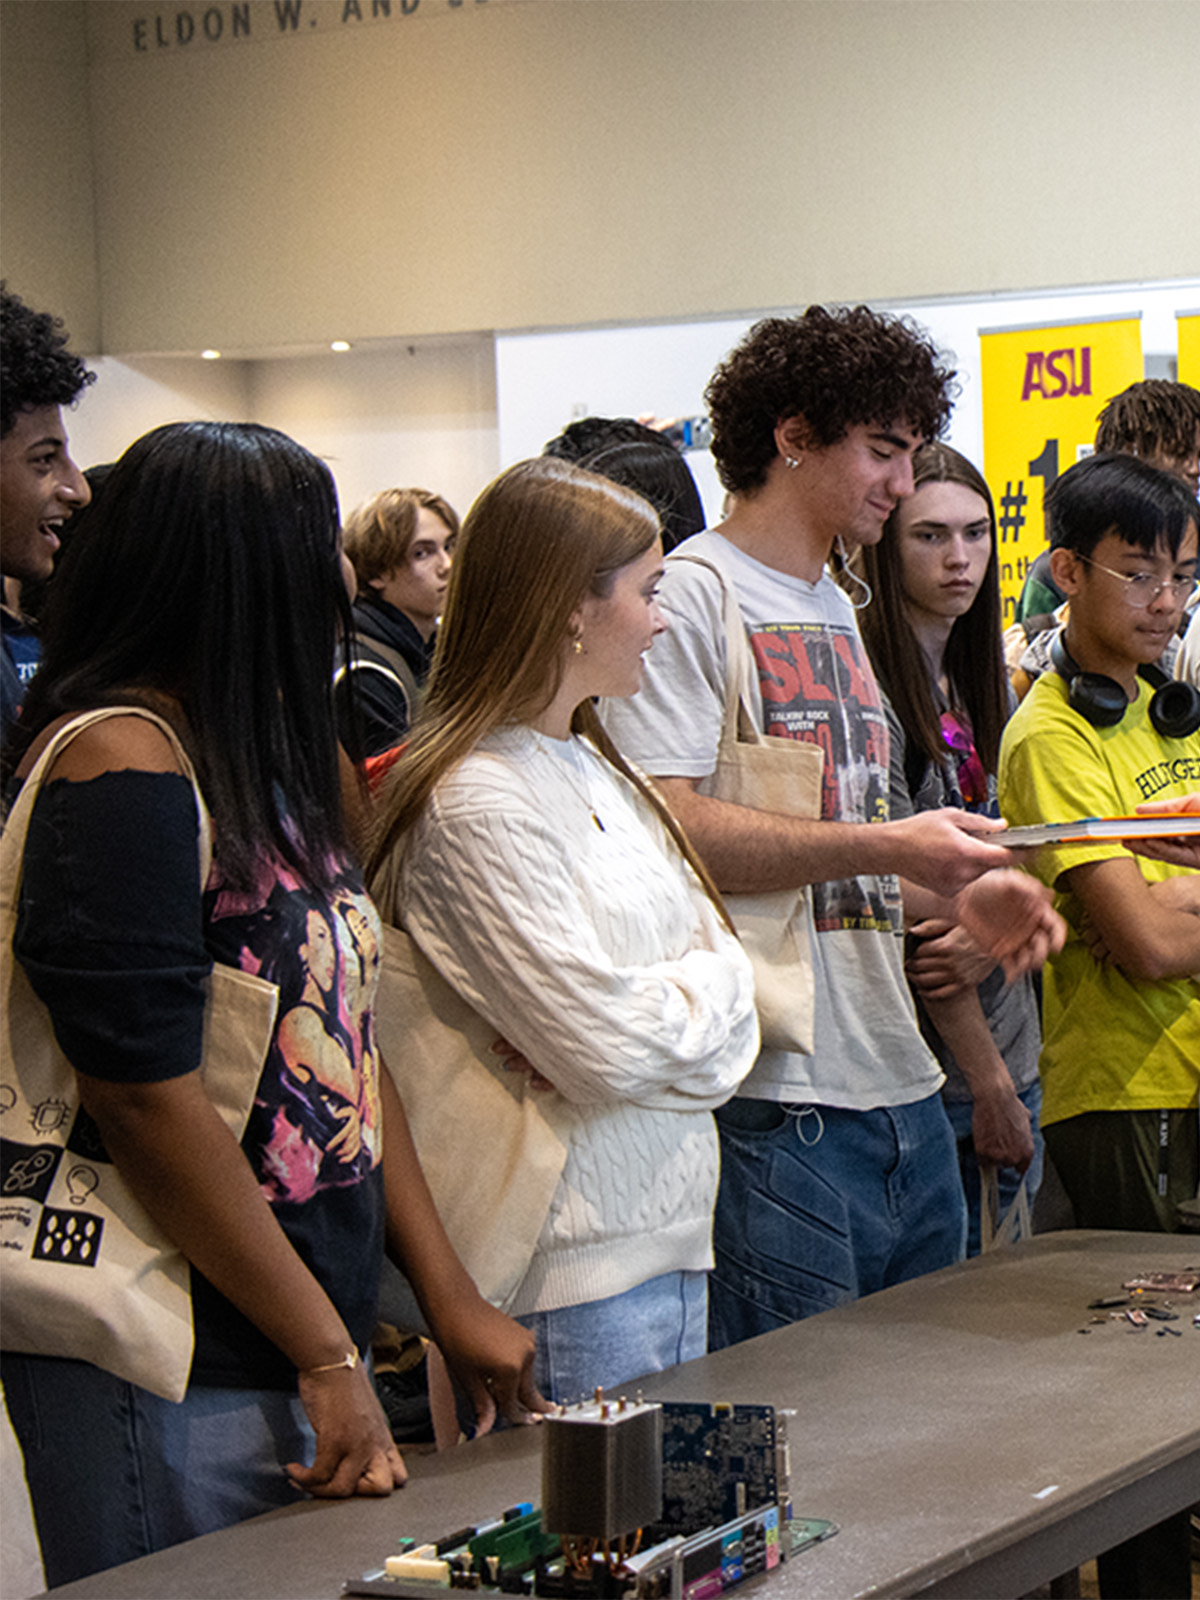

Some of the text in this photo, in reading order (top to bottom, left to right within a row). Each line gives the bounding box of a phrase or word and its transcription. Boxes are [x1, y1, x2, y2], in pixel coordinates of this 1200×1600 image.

[132, 4, 251, 52] ELDON
[274, 0, 318, 32] W.
[1021, 347, 1092, 401] ASU
